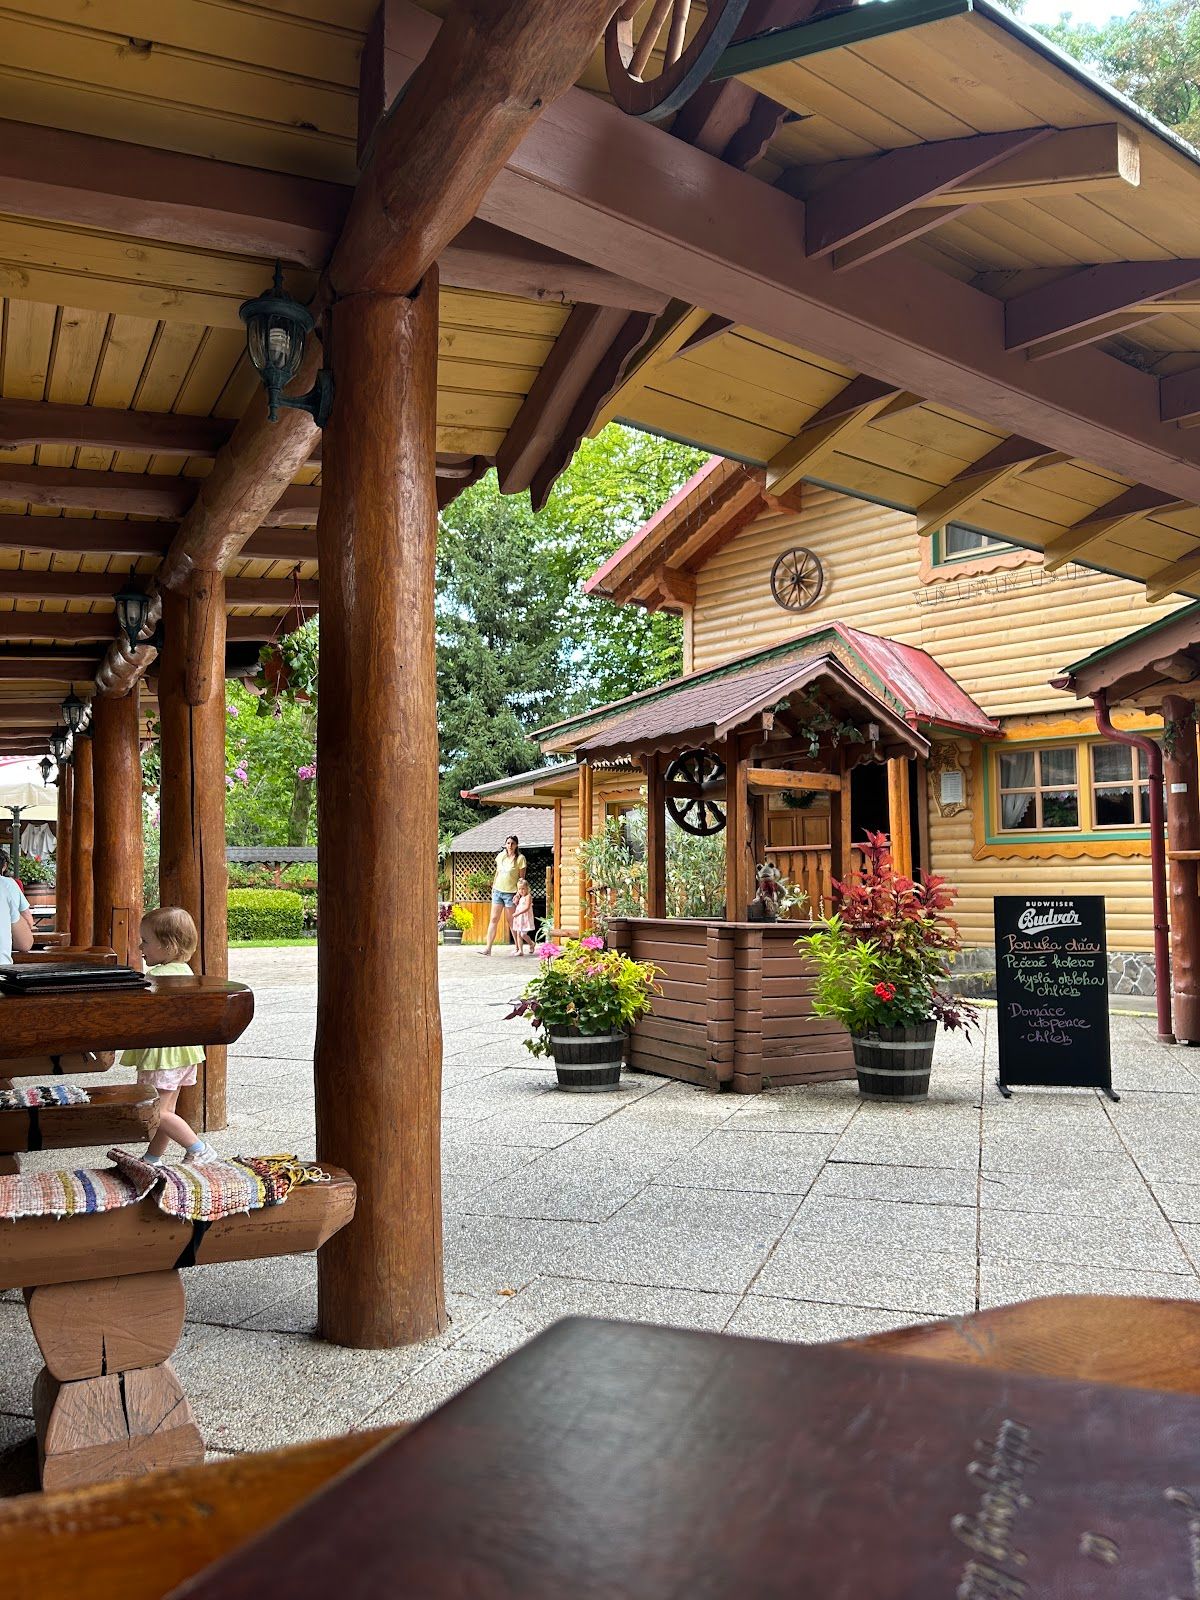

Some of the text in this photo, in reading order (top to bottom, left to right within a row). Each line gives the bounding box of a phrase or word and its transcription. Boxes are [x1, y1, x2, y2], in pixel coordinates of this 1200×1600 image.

[1018, 908, 1083, 933] Budvar
[1002, 934, 1062, 953] Ponuka
[1002, 954, 1096, 969] Pečené koleno
[1014, 969, 1054, 992] kyslá
[1037, 984, 1081, 997] chlieb
[1028, 1018, 1092, 1033] utopence
